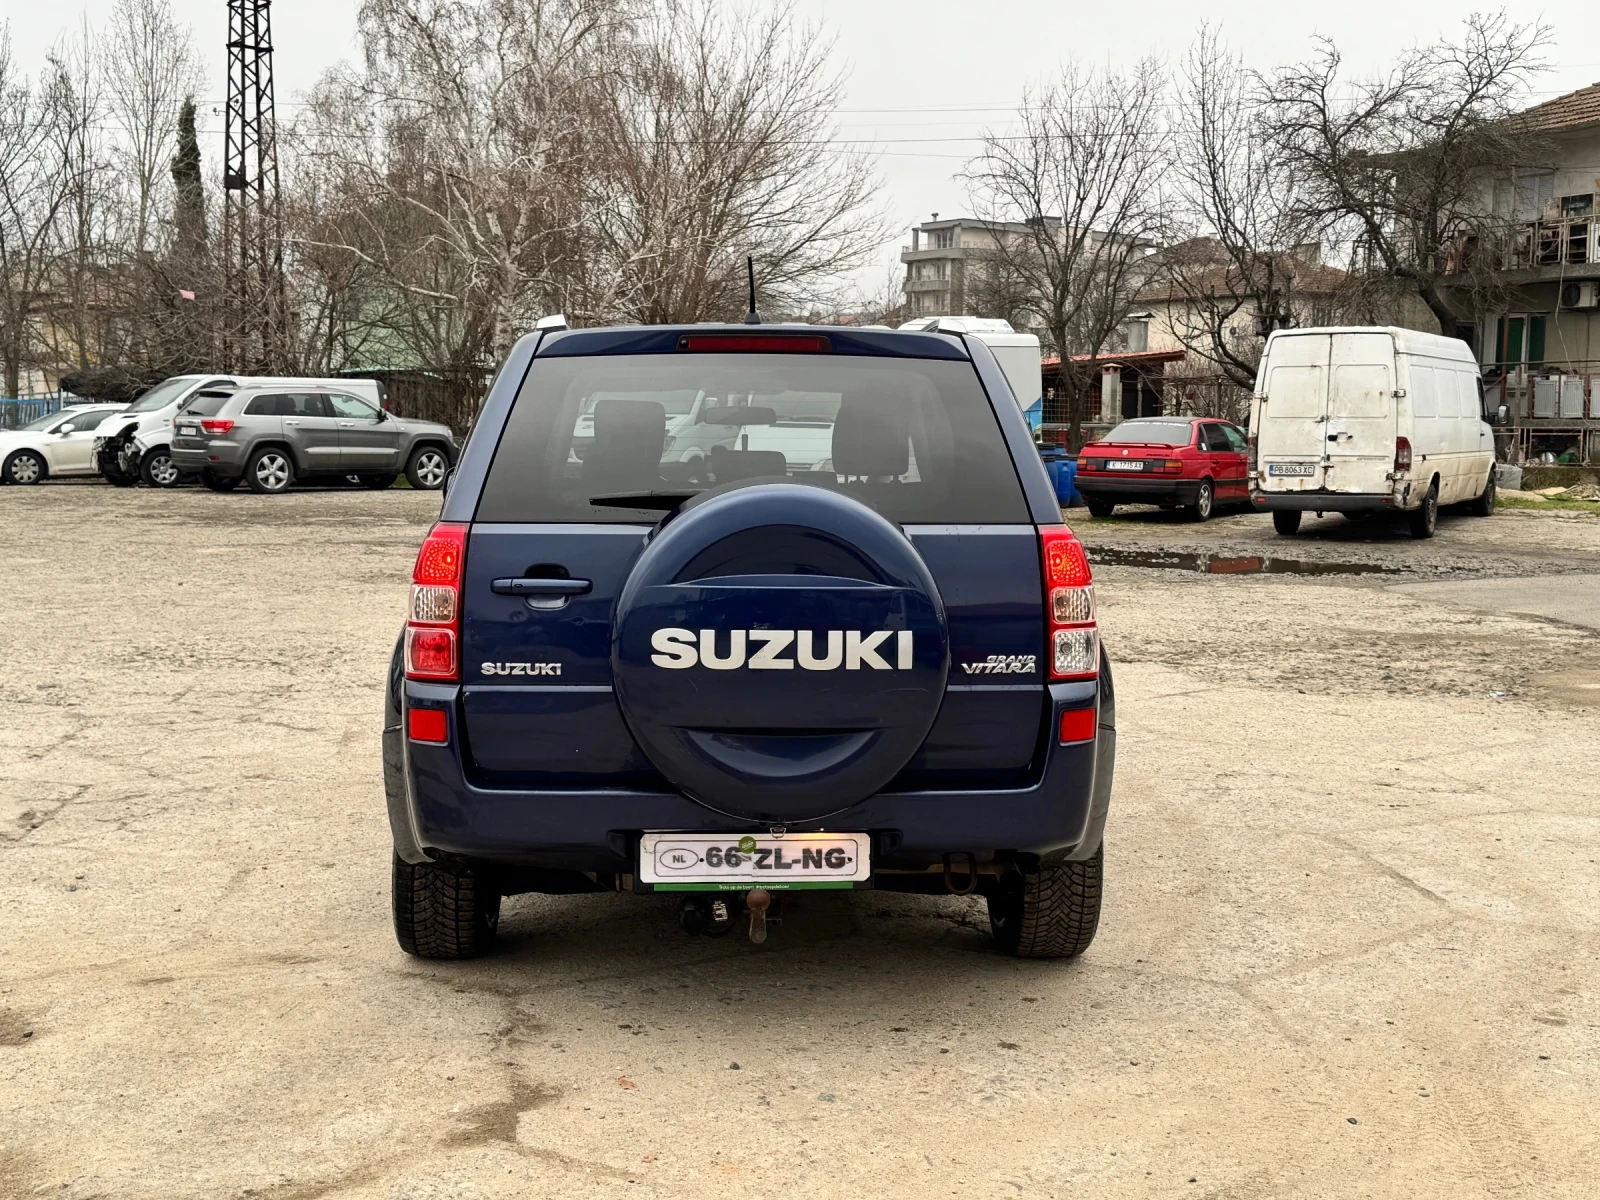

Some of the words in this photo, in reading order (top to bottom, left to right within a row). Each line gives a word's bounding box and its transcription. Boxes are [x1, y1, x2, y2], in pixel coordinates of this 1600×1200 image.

[1274, 466, 1284, 474] PB
[1284, 466, 1302, 474] 8063
[651, 627, 913, 671] SUZUKI
[986, 655, 1037, 663] GRAND
[481, 662, 562, 676] SUZUKI
[961, 662, 1036, 674] VITARA
[672, 854, 687, 864] NL
